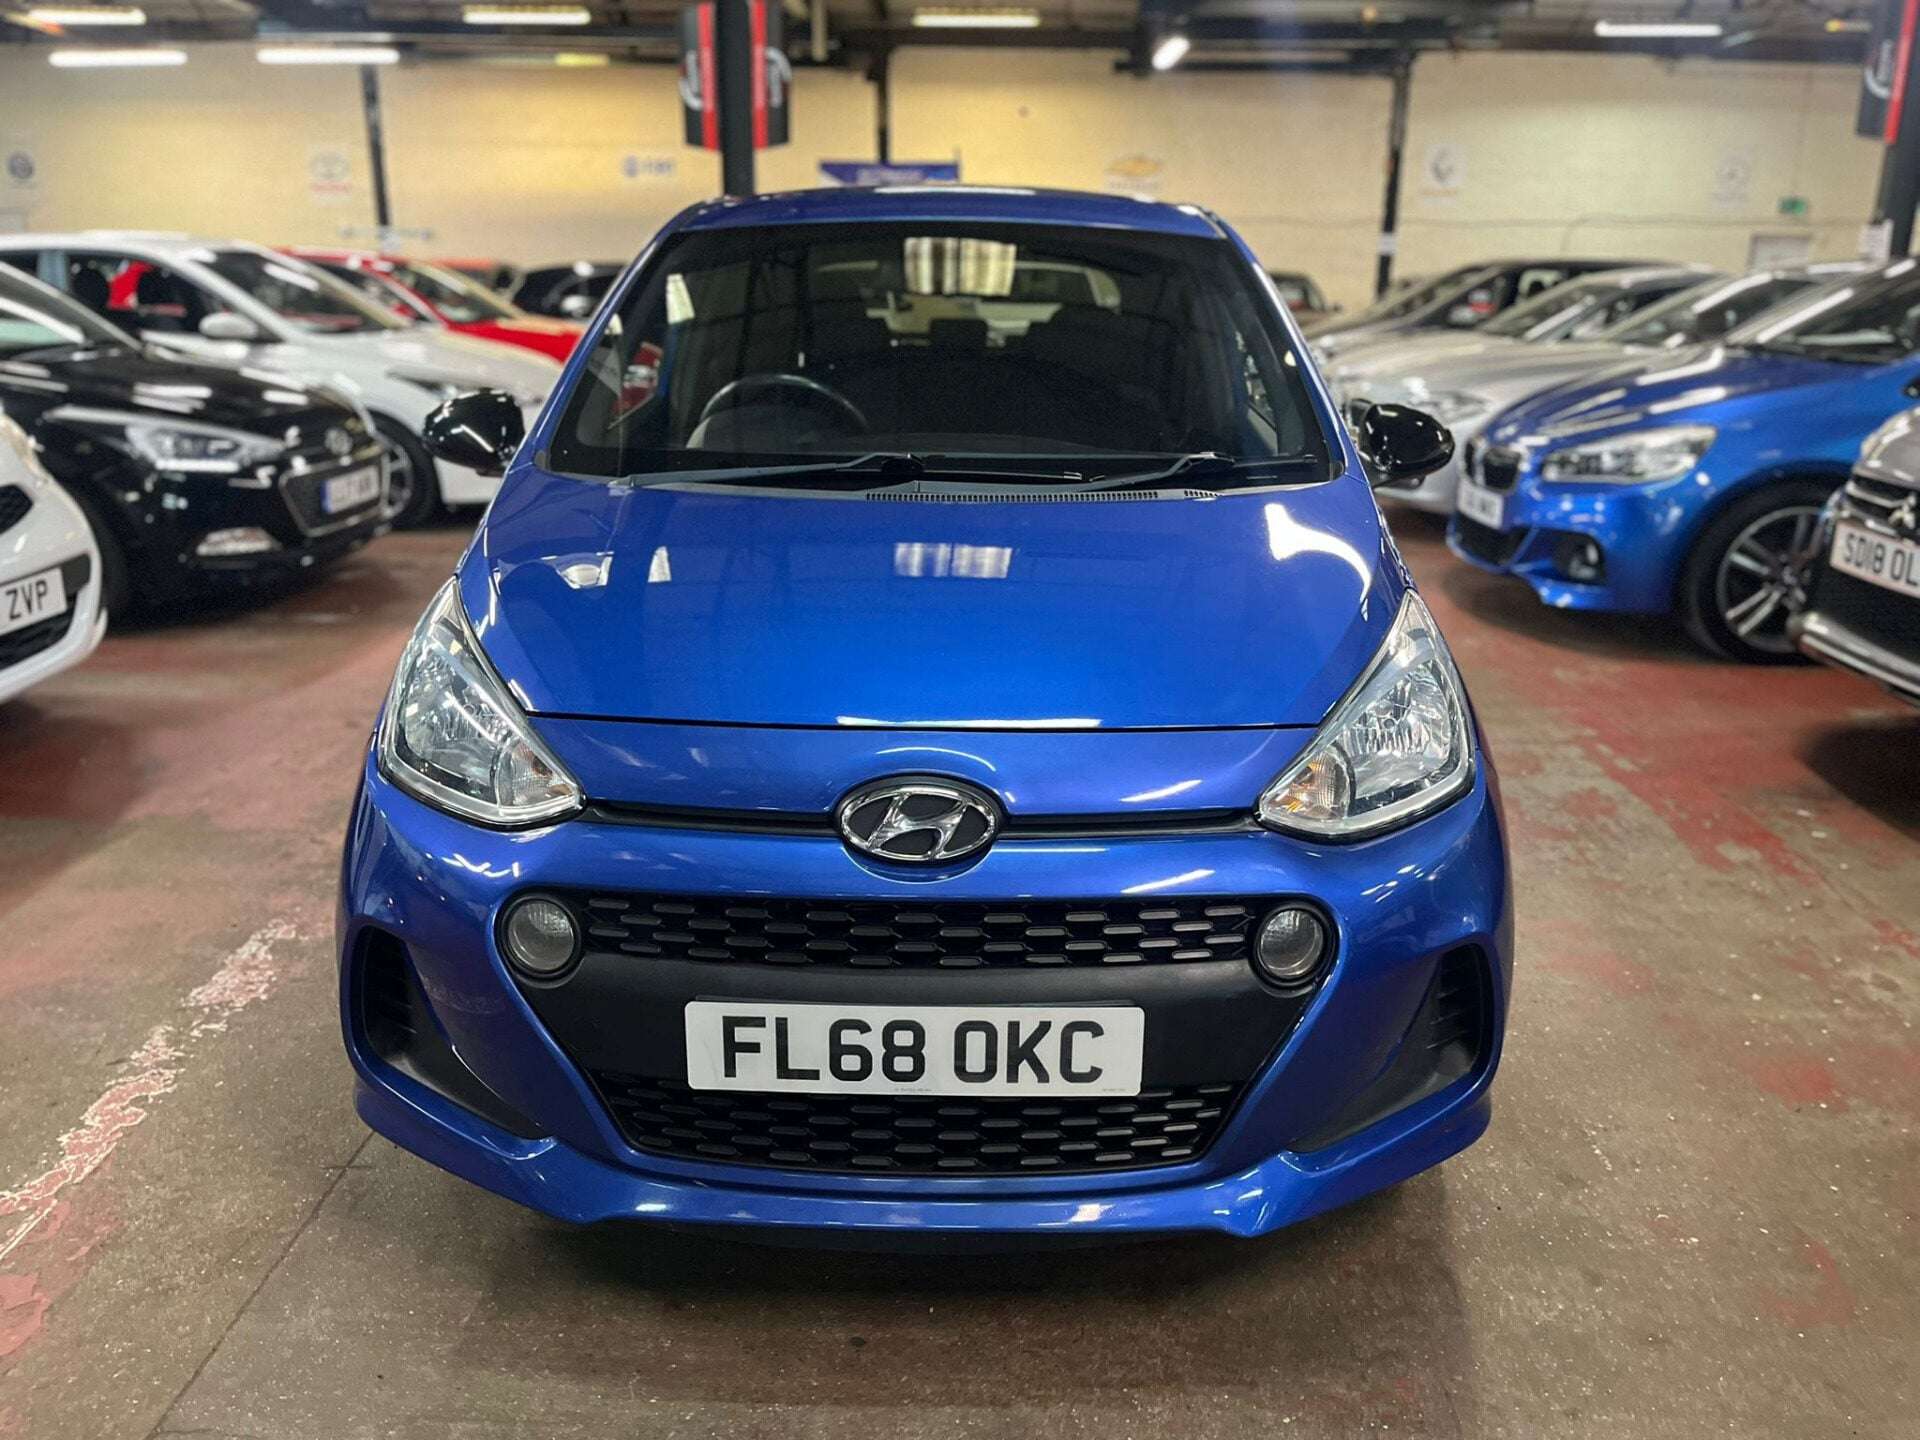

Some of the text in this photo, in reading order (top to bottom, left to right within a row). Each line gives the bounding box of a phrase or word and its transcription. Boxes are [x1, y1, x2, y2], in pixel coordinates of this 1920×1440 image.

[5, 580, 48, 621] ZVP
[722, 1016, 1105, 1084] FL68 OKC
